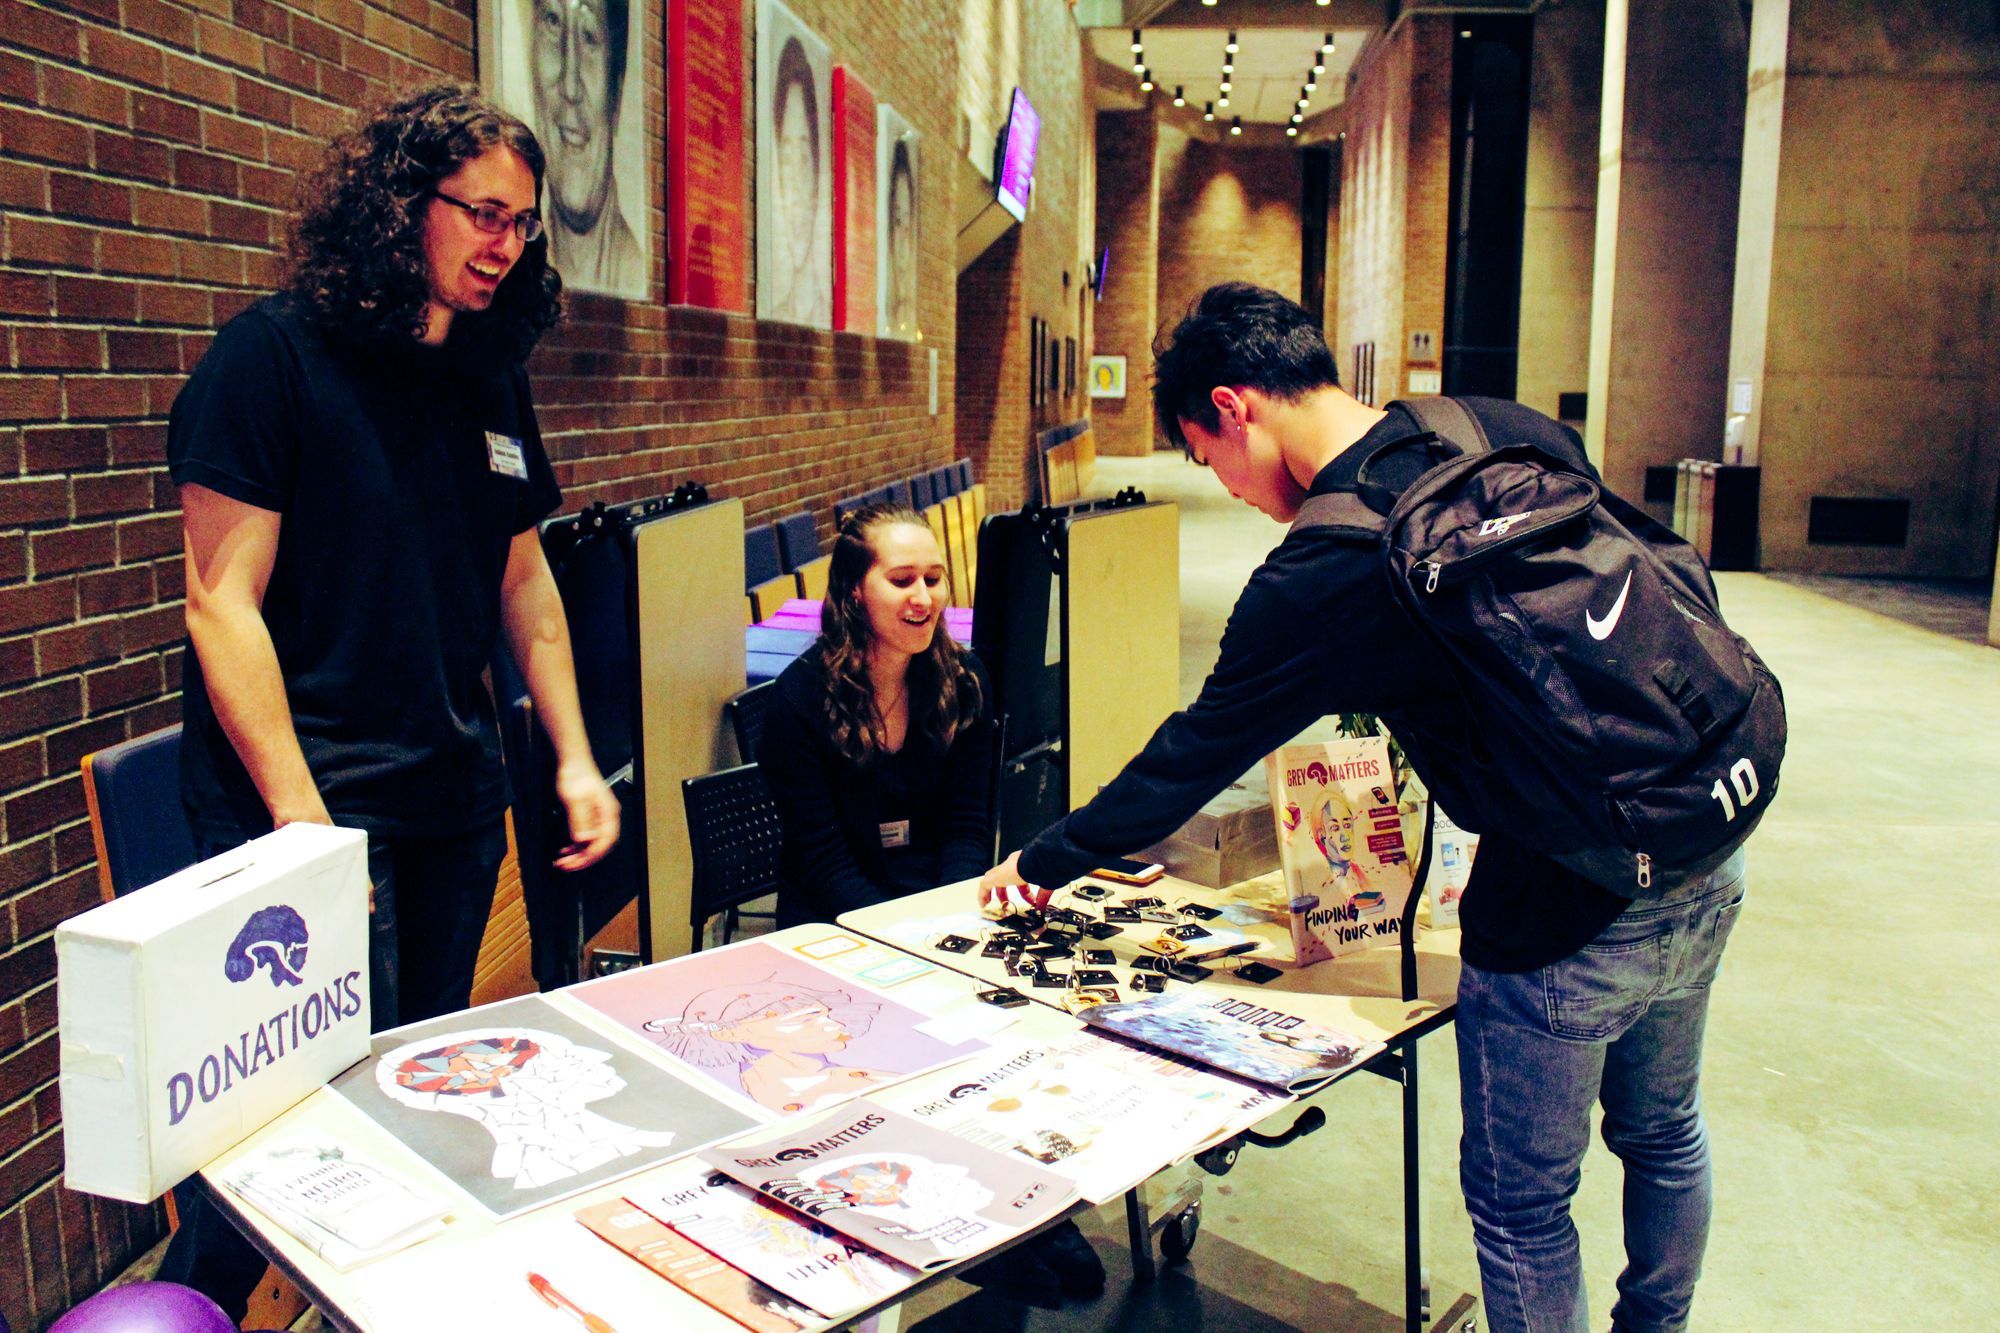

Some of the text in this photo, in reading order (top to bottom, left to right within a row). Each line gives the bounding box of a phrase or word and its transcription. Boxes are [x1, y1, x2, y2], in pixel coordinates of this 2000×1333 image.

[1286, 759, 1380, 788] GREY MATTERS
[1711, 758, 1759, 822] 10
[1304, 903, 1359, 932] FINDING
[1334, 923, 1372, 946] YOUR
[167, 971, 361, 1126] DONATIONS
[913, 1049, 1045, 1117] GREY MATTERS
[734, 1113, 885, 1169] GREY MATTERS
[300, 1170, 362, 1199] NEURO
[661, 1184, 710, 1206] GREY
